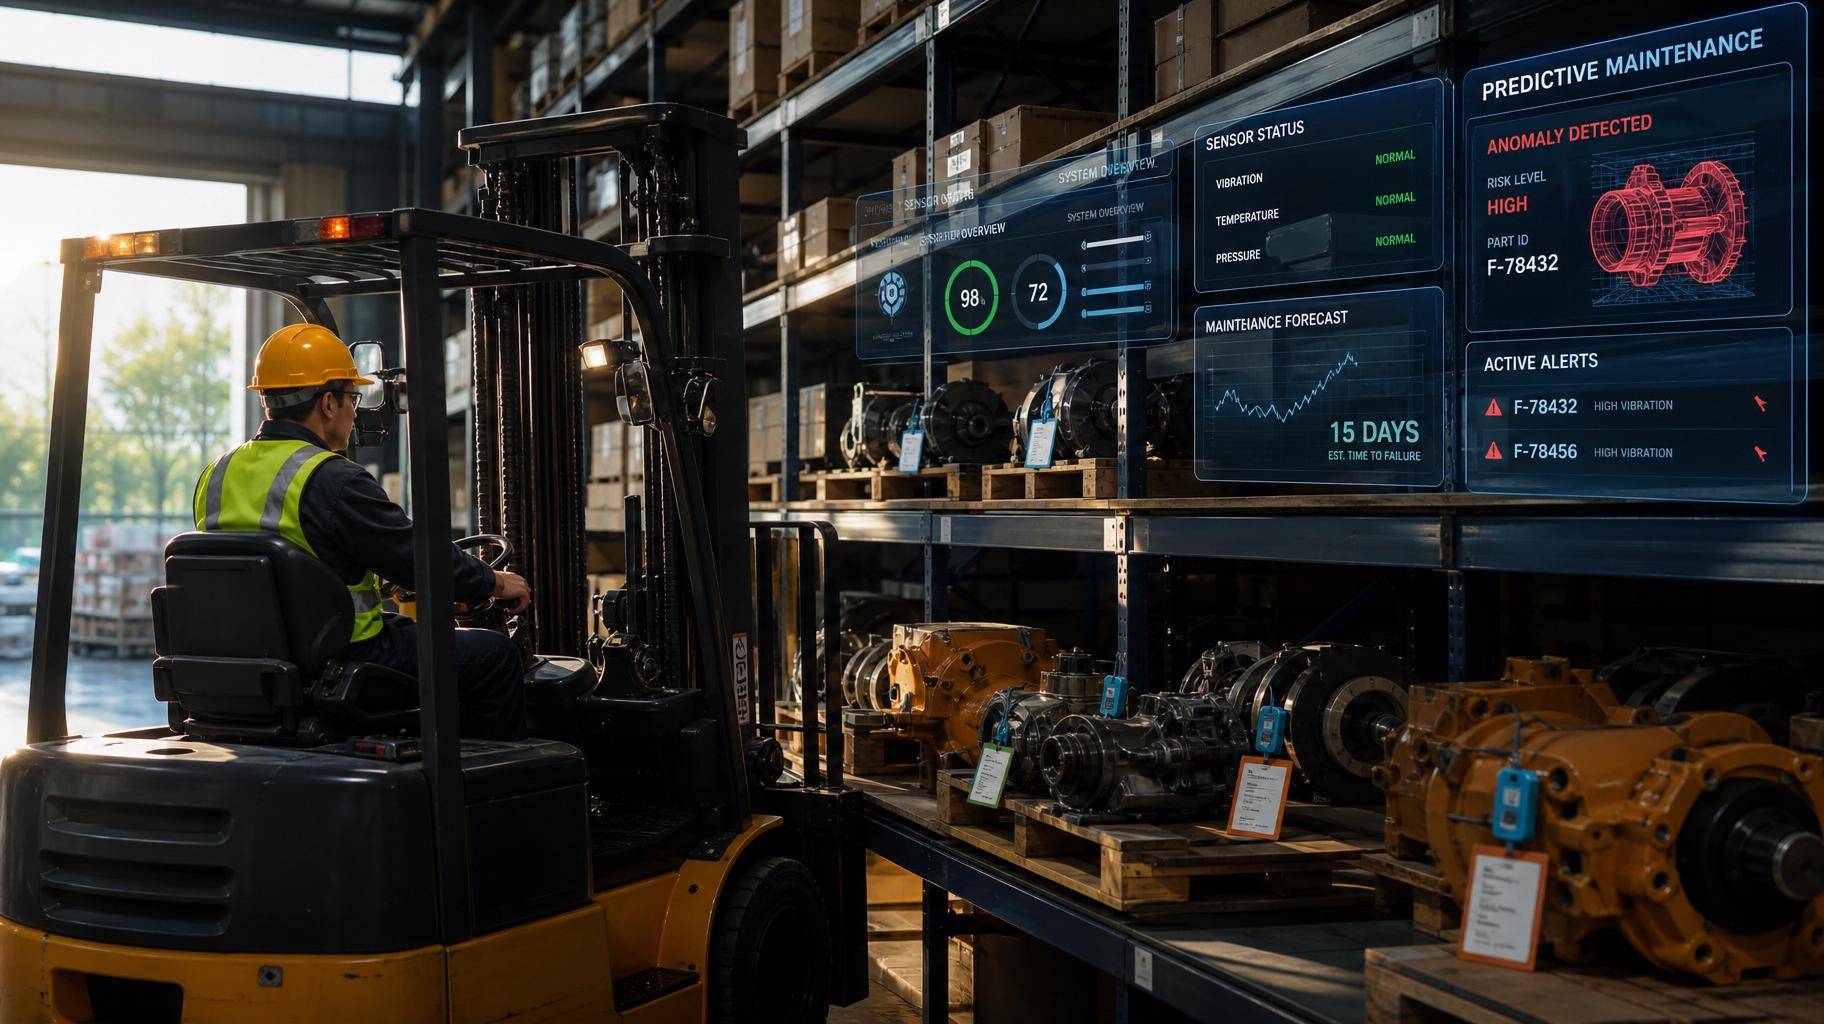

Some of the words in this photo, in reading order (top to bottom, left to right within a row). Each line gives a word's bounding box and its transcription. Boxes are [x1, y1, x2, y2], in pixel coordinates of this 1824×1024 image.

[1482, 60, 1599, 101] PREDICTIVE
[1606, 27, 1764, 77] MAINTENANCE
[1206, 129, 1254, 151] SENSOR
[1257, 120, 1305, 142] STATUS
[1487, 128, 1565, 155] ANOMALY
[1568, 113, 1653, 143] DETECTED
[1375, 149, 1416, 165] NORMAL
[1058, 166, 1098, 184] SYSTEM
[1215, 172, 1264, 189] VIBRATION
[1487, 175, 1512, 189] RISK
[1514, 170, 1547, 186] LEVEL
[1375, 191, 1416, 206] NORMAL
[1487, 195, 1528, 216] HIGH
[1067, 209, 1097, 223] SYSTEM
[1216, 208, 1280, 227] TEMPERATURE
[960, 221, 1006, 239] OVERVIEW
[1375, 233, 1416, 247] NORMAL
[1487, 235, 1514, 249] PART
[1517, 234, 1529, 246] ID
[1216, 249, 1261, 264] PRESSURE
[1487, 253, 1559, 276] F-78432
[1028, 282, 1048, 302] 72
[1285, 310, 1349, 328] FORECAST
[1484, 355, 1536, 372] ACTIVE
[1540, 352, 1599, 370] ALERTS
[1514, 398, 1578, 415] F-78432
[1594, 400, 1618, 411] HIGH
[1622, 400, 1674, 411] VIBRATION
[1330, 420, 1355, 443] 15
[1362, 420, 1420, 443] DAYS
[1328, 450, 1346, 460] EST.
[1347, 450, 1369, 461] TIME
[1370, 451, 1382, 461] TO
[1384, 451, 1421, 461] FAILURE
[1514, 443, 1578, 459] F-78456
[1594, 447, 1618, 458] HIGH
[1622, 448, 1674, 458] VIBRATION
